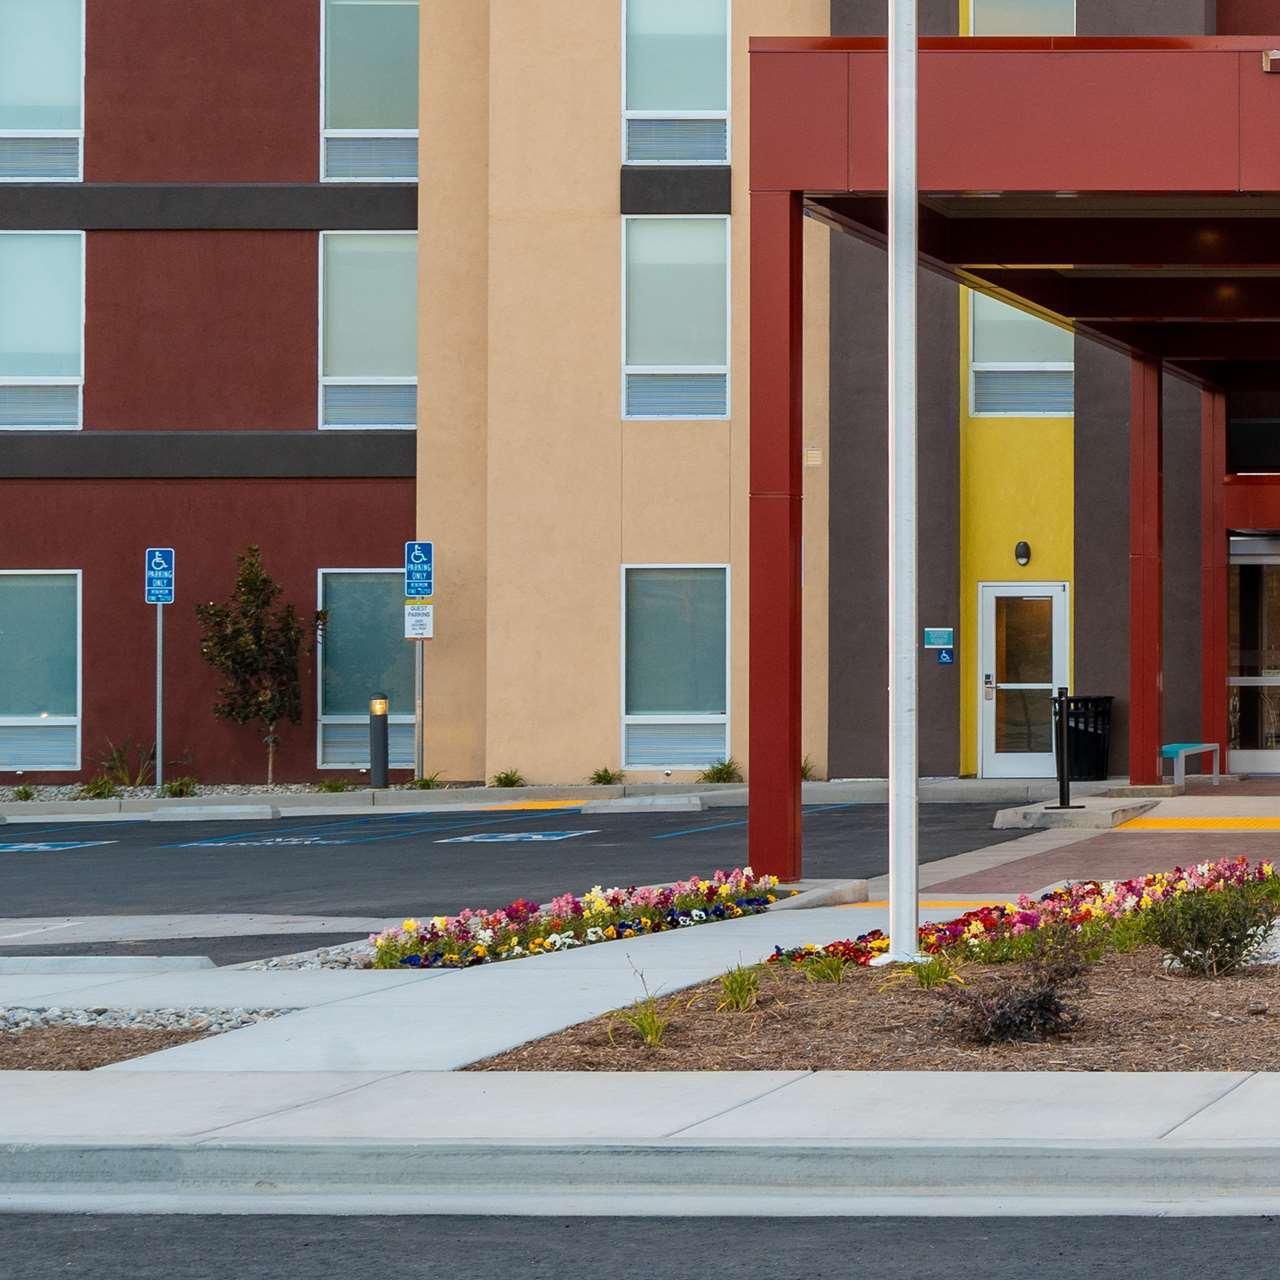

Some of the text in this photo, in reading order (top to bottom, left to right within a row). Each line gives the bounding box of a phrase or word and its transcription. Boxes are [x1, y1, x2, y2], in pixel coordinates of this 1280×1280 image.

[407, 563, 432, 571] PARKING
[147, 570, 173, 578] PARKING
[412, 572, 427, 580] ONLY
[152, 579, 167, 587] ONLY
